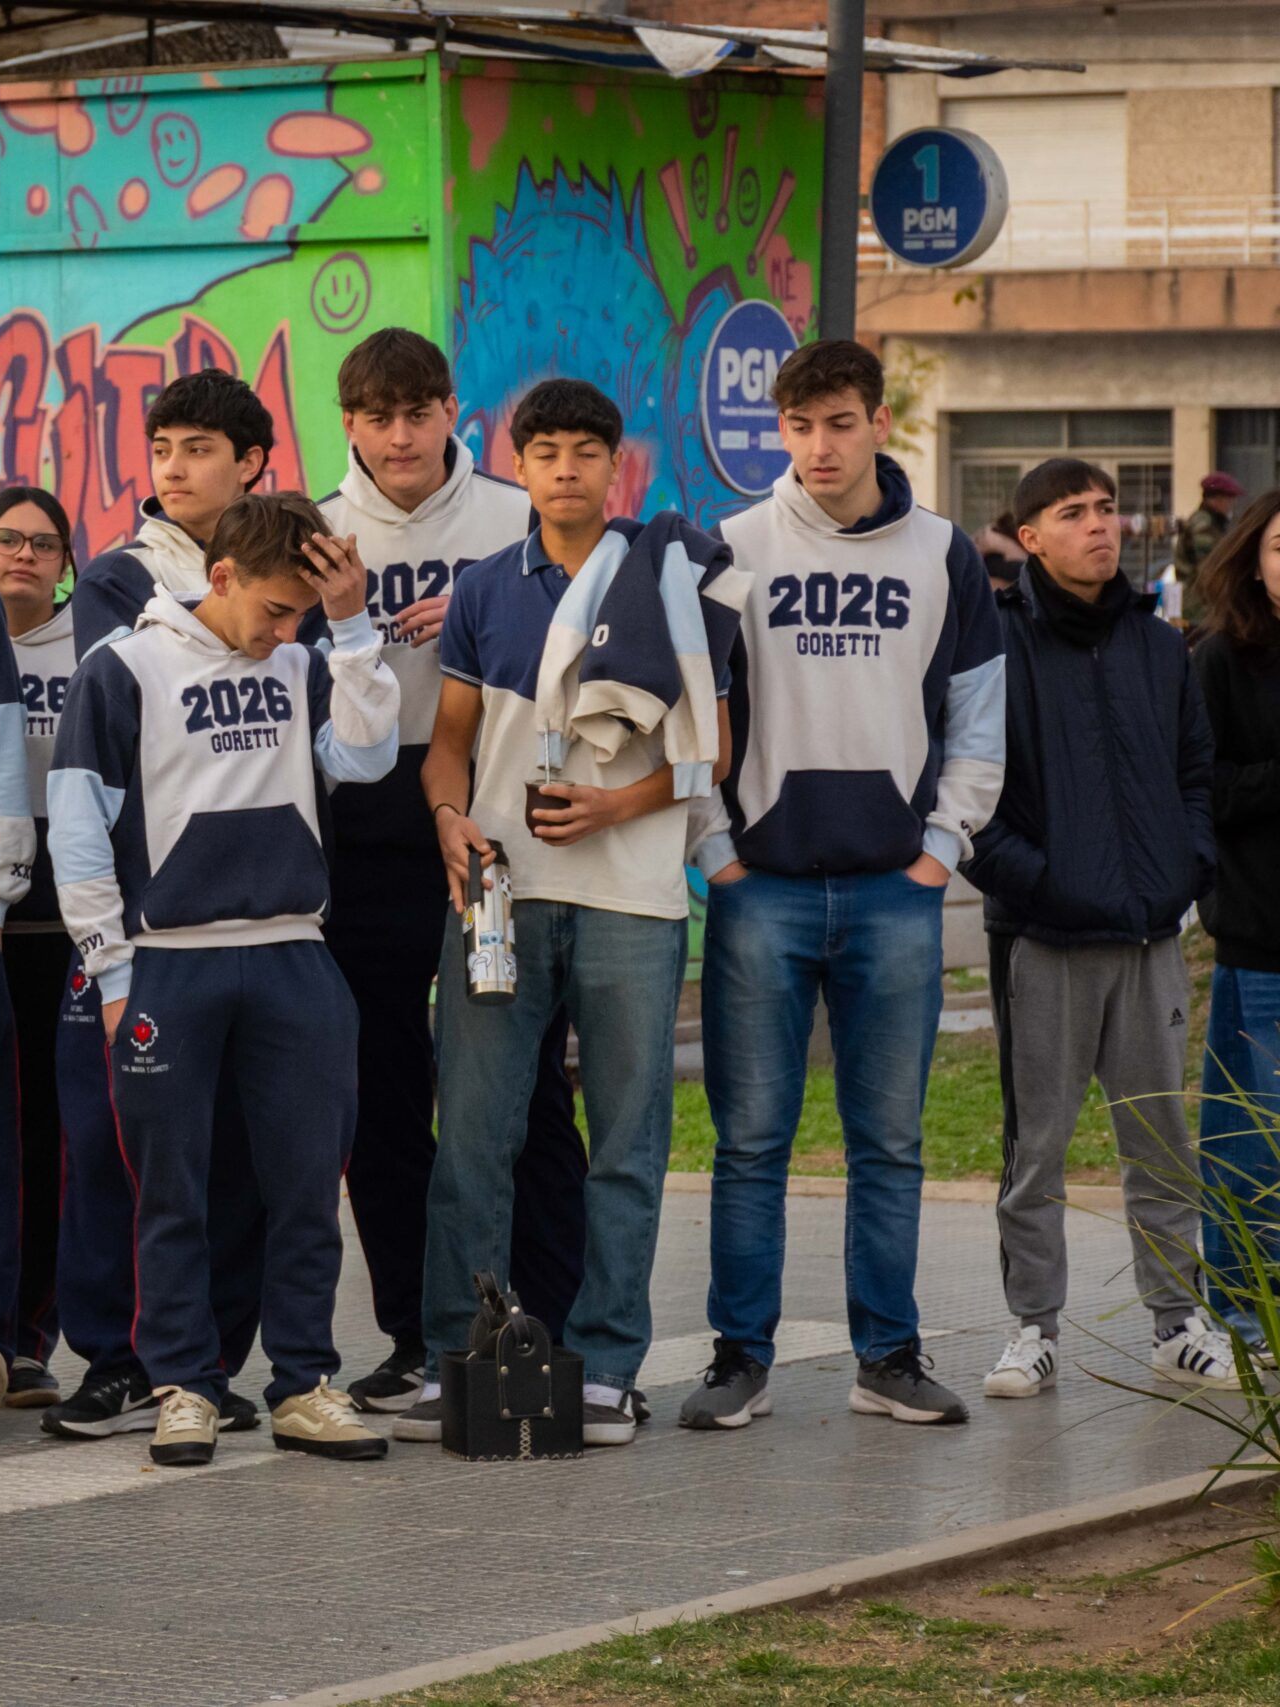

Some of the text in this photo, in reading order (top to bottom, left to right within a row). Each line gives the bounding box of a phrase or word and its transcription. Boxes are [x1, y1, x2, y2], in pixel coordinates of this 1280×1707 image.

[913, 144, 940, 203] 1
[903, 207, 957, 232] PGM
[768, 572, 910, 630] 2026
[797, 632, 881, 657] GORETTI
[21, 673, 71, 714] 26
[181, 676, 293, 734] 2026
[210, 727, 280, 754] GORETTI
